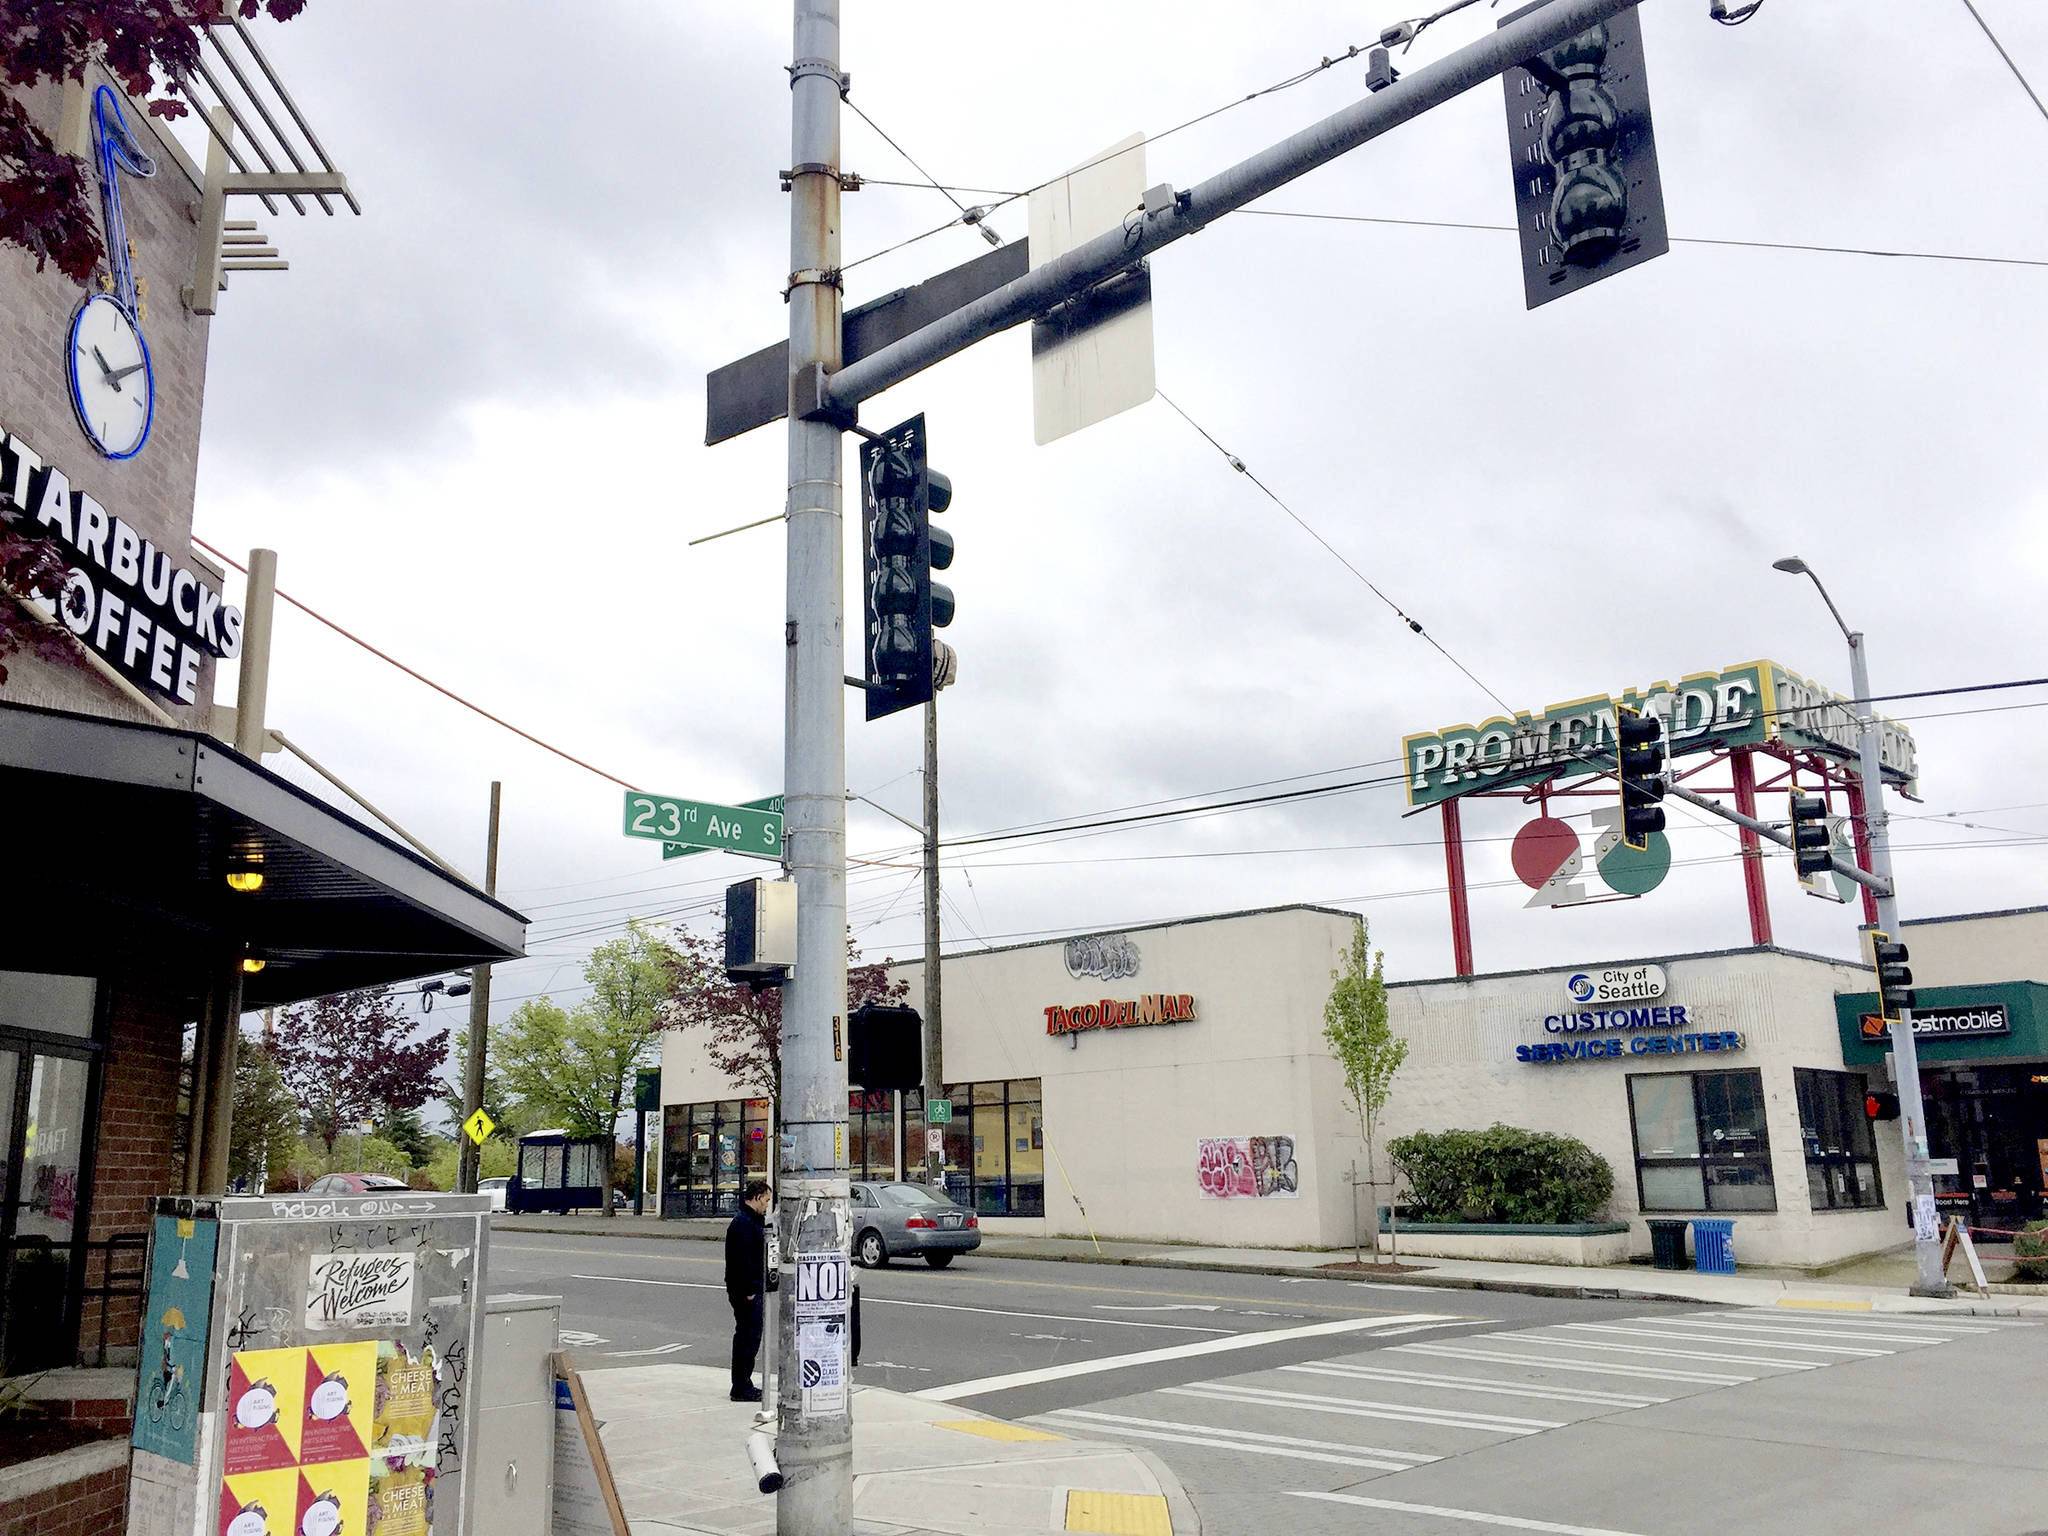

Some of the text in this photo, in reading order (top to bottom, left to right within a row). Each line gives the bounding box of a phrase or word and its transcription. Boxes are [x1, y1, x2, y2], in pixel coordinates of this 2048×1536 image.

[0, 425, 242, 659] TARBUCKS
[30, 567, 202, 705] OFFEE
[706, 814, 742, 840] Ave
[763, 823, 776, 845] S
[1599, 981, 1660, 999] Seattle
[1603, 968, 1648, 984] City of
[1044, 1004, 1098, 1035] TACO
[1136, 993, 1196, 1025] MAR
[1544, 1005, 1691, 1034] CUSTOMER
[833, 1017, 842, 1061] 316
[1516, 1031, 1745, 1063] SERVICE CENTER
[315, 1257, 411, 1292] Refugees
[798, 1262, 845, 1300] NO!
[308, 1277, 409, 1320] Welcome
[391, 1369, 431, 1384] CHEESE
[400, 1381, 431, 1394] MEAT
[382, 1486, 425, 1502] CHEESE
[392, 1498, 424, 1513] MEAT
